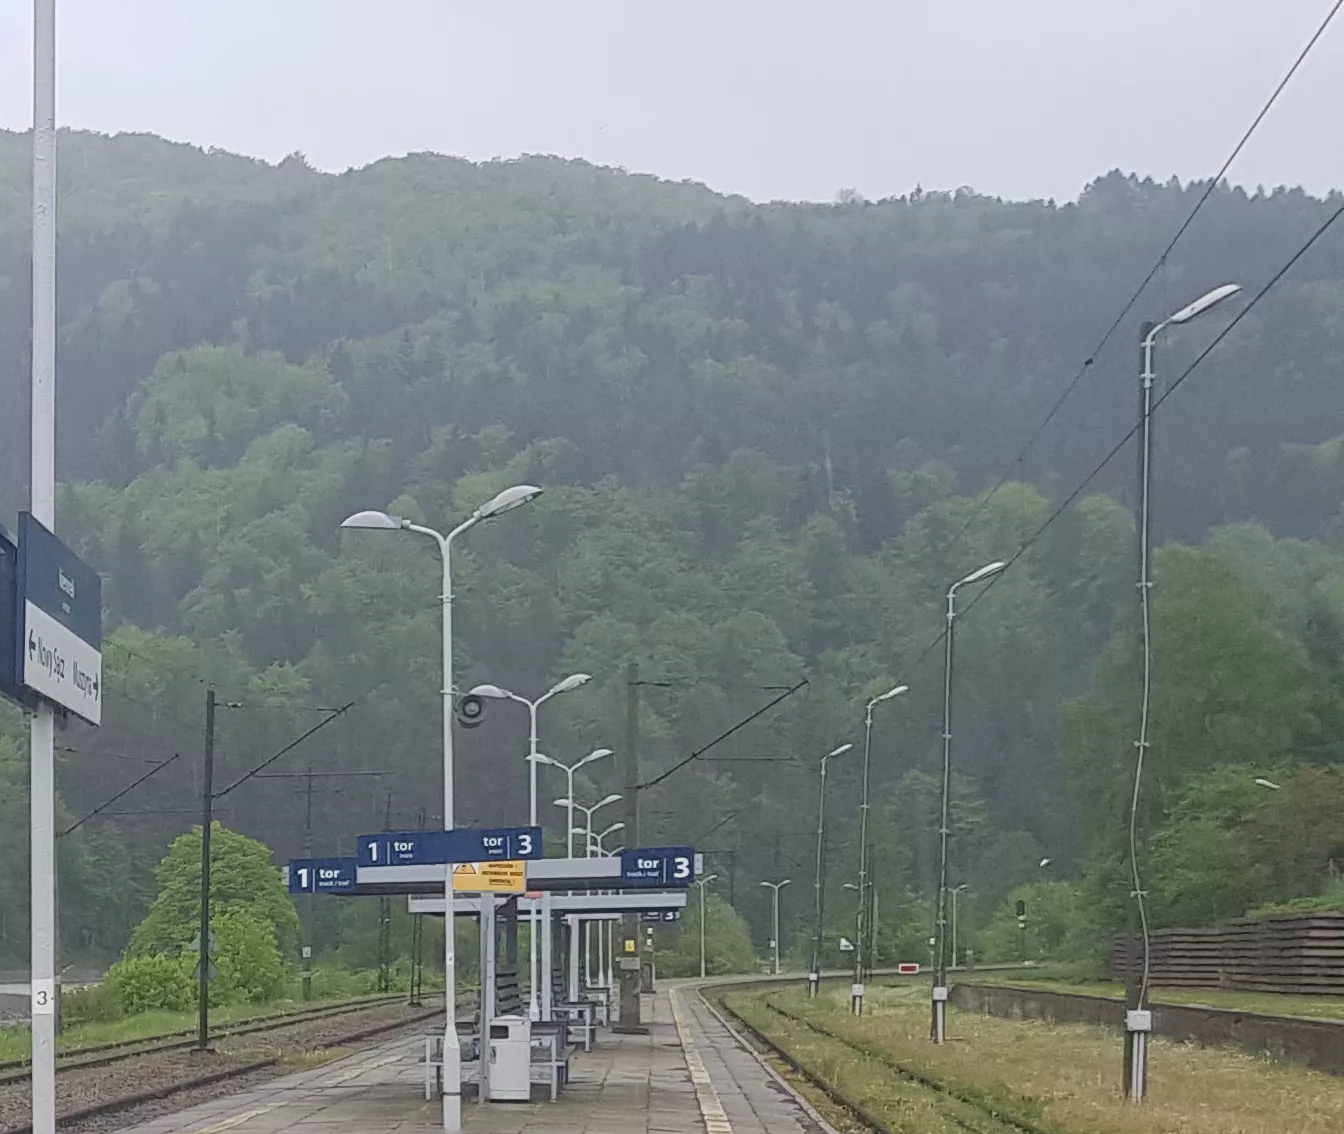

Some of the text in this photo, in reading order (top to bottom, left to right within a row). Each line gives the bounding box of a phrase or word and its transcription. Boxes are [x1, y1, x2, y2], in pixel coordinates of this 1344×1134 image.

[368, 841, 413, 861] 1 tor
[482, 834, 532, 855] tor 3
[297, 868, 340, 888] 1 tor
[637, 857, 691, 879] tor 3
[36, 990, 48, 1006] 3
